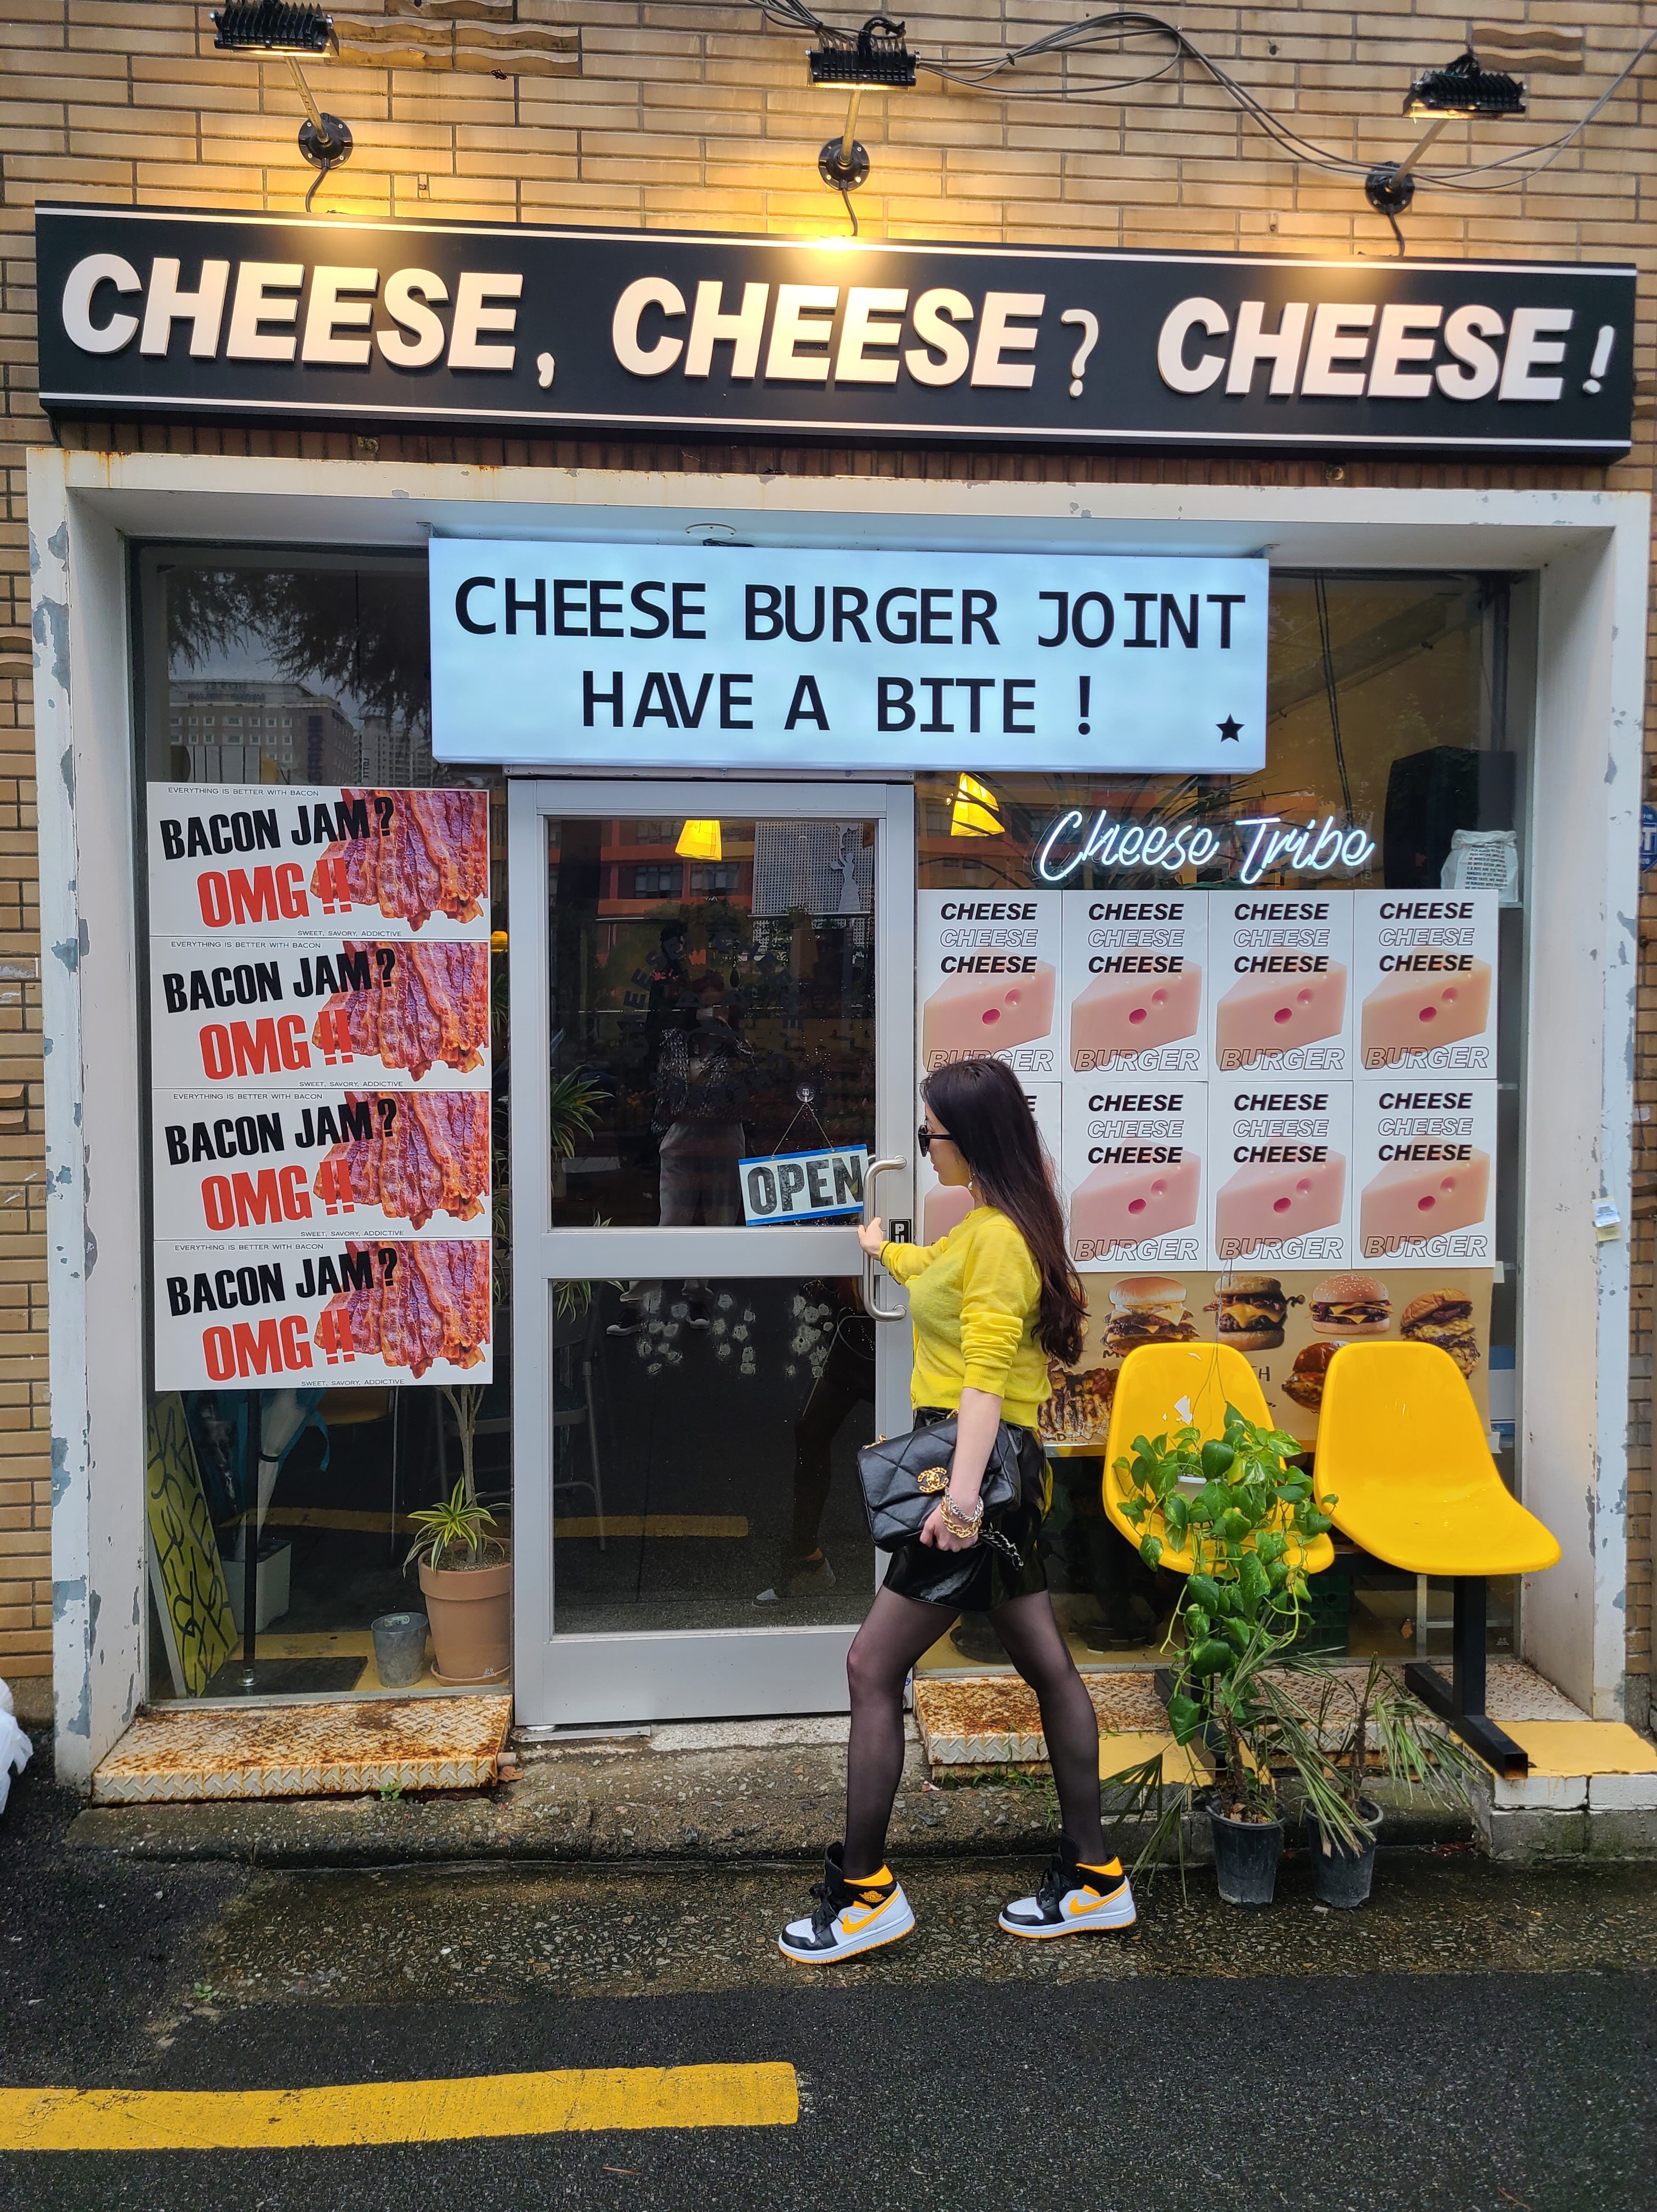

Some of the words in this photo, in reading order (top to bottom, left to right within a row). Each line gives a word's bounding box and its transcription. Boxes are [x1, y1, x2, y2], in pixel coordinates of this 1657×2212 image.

[455, 576, 707, 640] CHEESE
[744, 585, 1000, 646] BURGER
[1037, 591, 1246, 650] JOINT
[582, 670, 754, 730] HAVE
[784, 674, 830, 731] A
[877, 677, 1036, 734] BITE
[160, 808, 281, 861] BACON
[1040, 810, 1219, 881] Cheese
[1235, 814, 1375, 885] Tribe
[940, 903, 1038, 920] CHEESE
[1088, 903, 1184, 920] CHEESE
[1234, 903, 1330, 920] CHEESE
[1380, 902, 1474, 919] CHEESE
[940, 929, 1039, 948] CHEESE
[1088, 929, 1184, 948] CHEESE
[1233, 929, 1330, 947] CHEESE
[1379, 928, 1475, 946] CHEESE
[940, 956, 1037, 973] CHEESE
[1088, 956, 1184, 973] CHEESE
[1234, 955, 1329, 972] CHEESE
[1379, 955, 1474, 971] CHEESE
[162, 961, 283, 1014] BACON
[1074, 1049, 1200, 1071] BURGER
[1219, 1048, 1345, 1070] BURGER
[1365, 1046, 1489, 1069] BURGER
[1088, 1094, 1183, 1111] CHEESE
[1234, 1094, 1329, 1111] CHEESE
[1379, 1093, 1473, 1110] CHEESE
[1088, 1120, 1184, 1138] CHEESE
[1233, 1119, 1329, 1137] CHEESE
[1378, 1118, 1473, 1136] CHEESE
[164, 1112, 285, 1166] BACON
[1088, 1147, 1183, 1164] CHEESE
[1234, 1146, 1328, 1163] CHEESE
[1378, 1144, 1473, 1161] CHEESE
[747, 1156, 864, 1215] OPEN
[1074, 1238, 1199, 1261] BURGER
[1219, 1237, 1344, 1260] BURGER
[1364, 1235, 1488, 1258] BURGER
[166, 1263, 285, 1317] BACON
